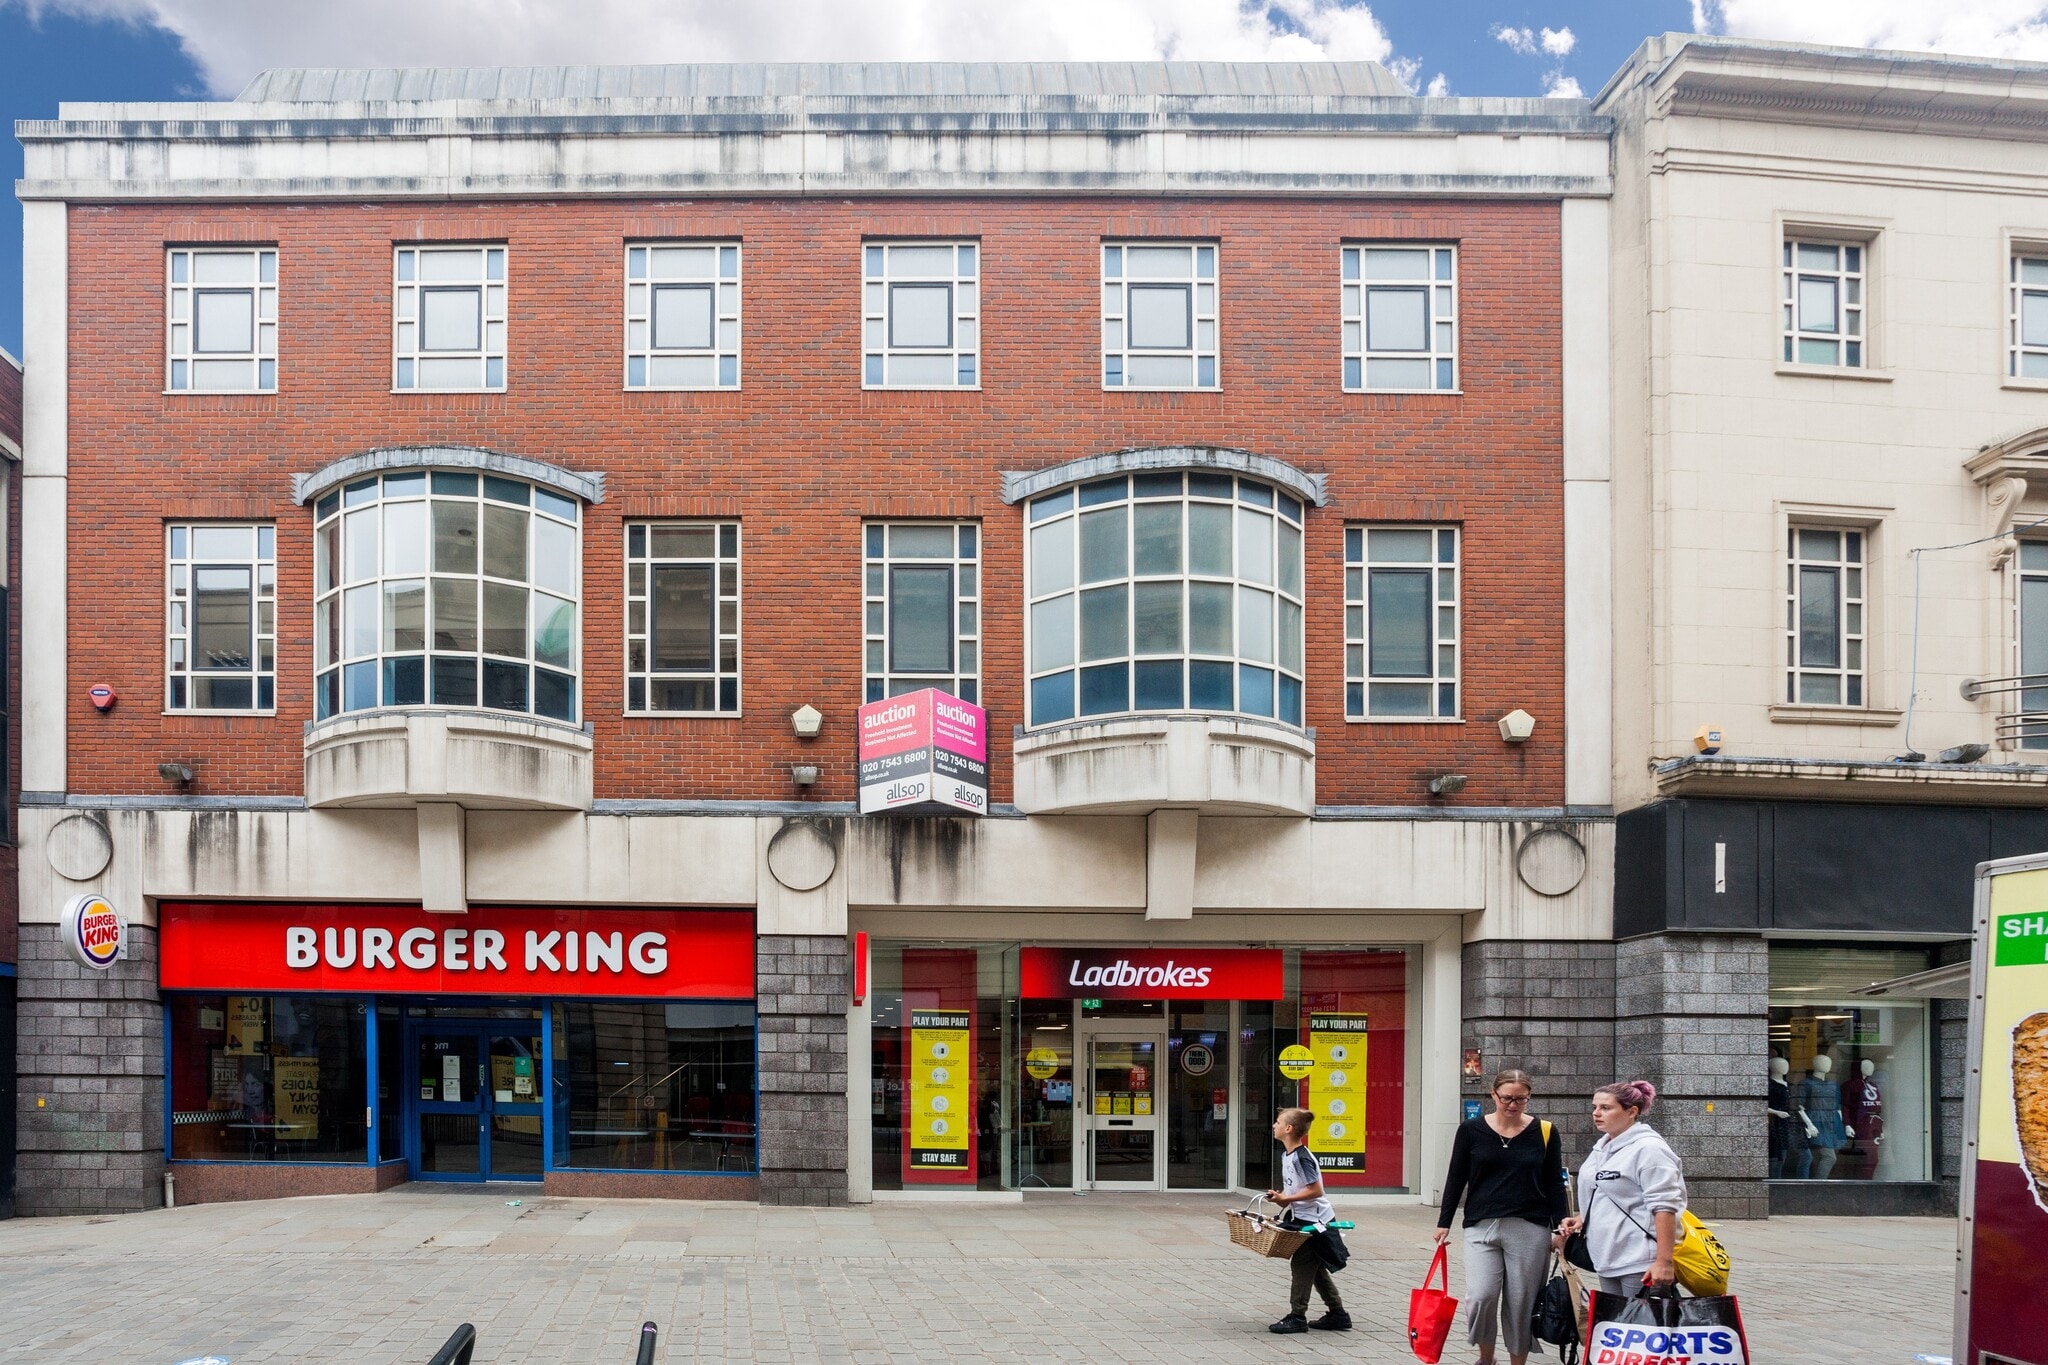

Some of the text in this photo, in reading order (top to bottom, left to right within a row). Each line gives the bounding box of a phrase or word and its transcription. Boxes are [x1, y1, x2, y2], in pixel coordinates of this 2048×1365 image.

[864, 703, 916, 729] auction
[936, 701, 976, 729] auction
[865, 723, 913, 739] Freehold Investment
[937, 720, 974, 738] Freehold Investment
[937, 728, 977, 747] Business Not Affected
[865, 730, 917, 747] Business Not Affected
[863, 750, 927, 773] 020 7543 6800
[935, 749, 985, 775] 020 7543 6800
[886, 782, 925, 800] allsop
[954, 784, 983, 808] allsop
[83, 913, 117, 931] BURGER
[2003, 917, 2048, 938] SH
[84, 925, 119, 948] KING
[285, 925, 670, 975] BURGER KING
[1068, 958, 1212, 989] Ladbrokes
[913, 1016, 969, 1027] PLAY YOUR PART
[1312, 1020, 1367, 1030] PLAY YOUR PART
[1188, 1058, 1206, 1066] ODDS
[214, 1068, 238, 1081] FIRE
[922, 1153, 957, 1163] STAY SAFE
[1319, 1156, 1354, 1167] STAY SAFE
[1600, 1328, 1733, 1355] SPORTS
